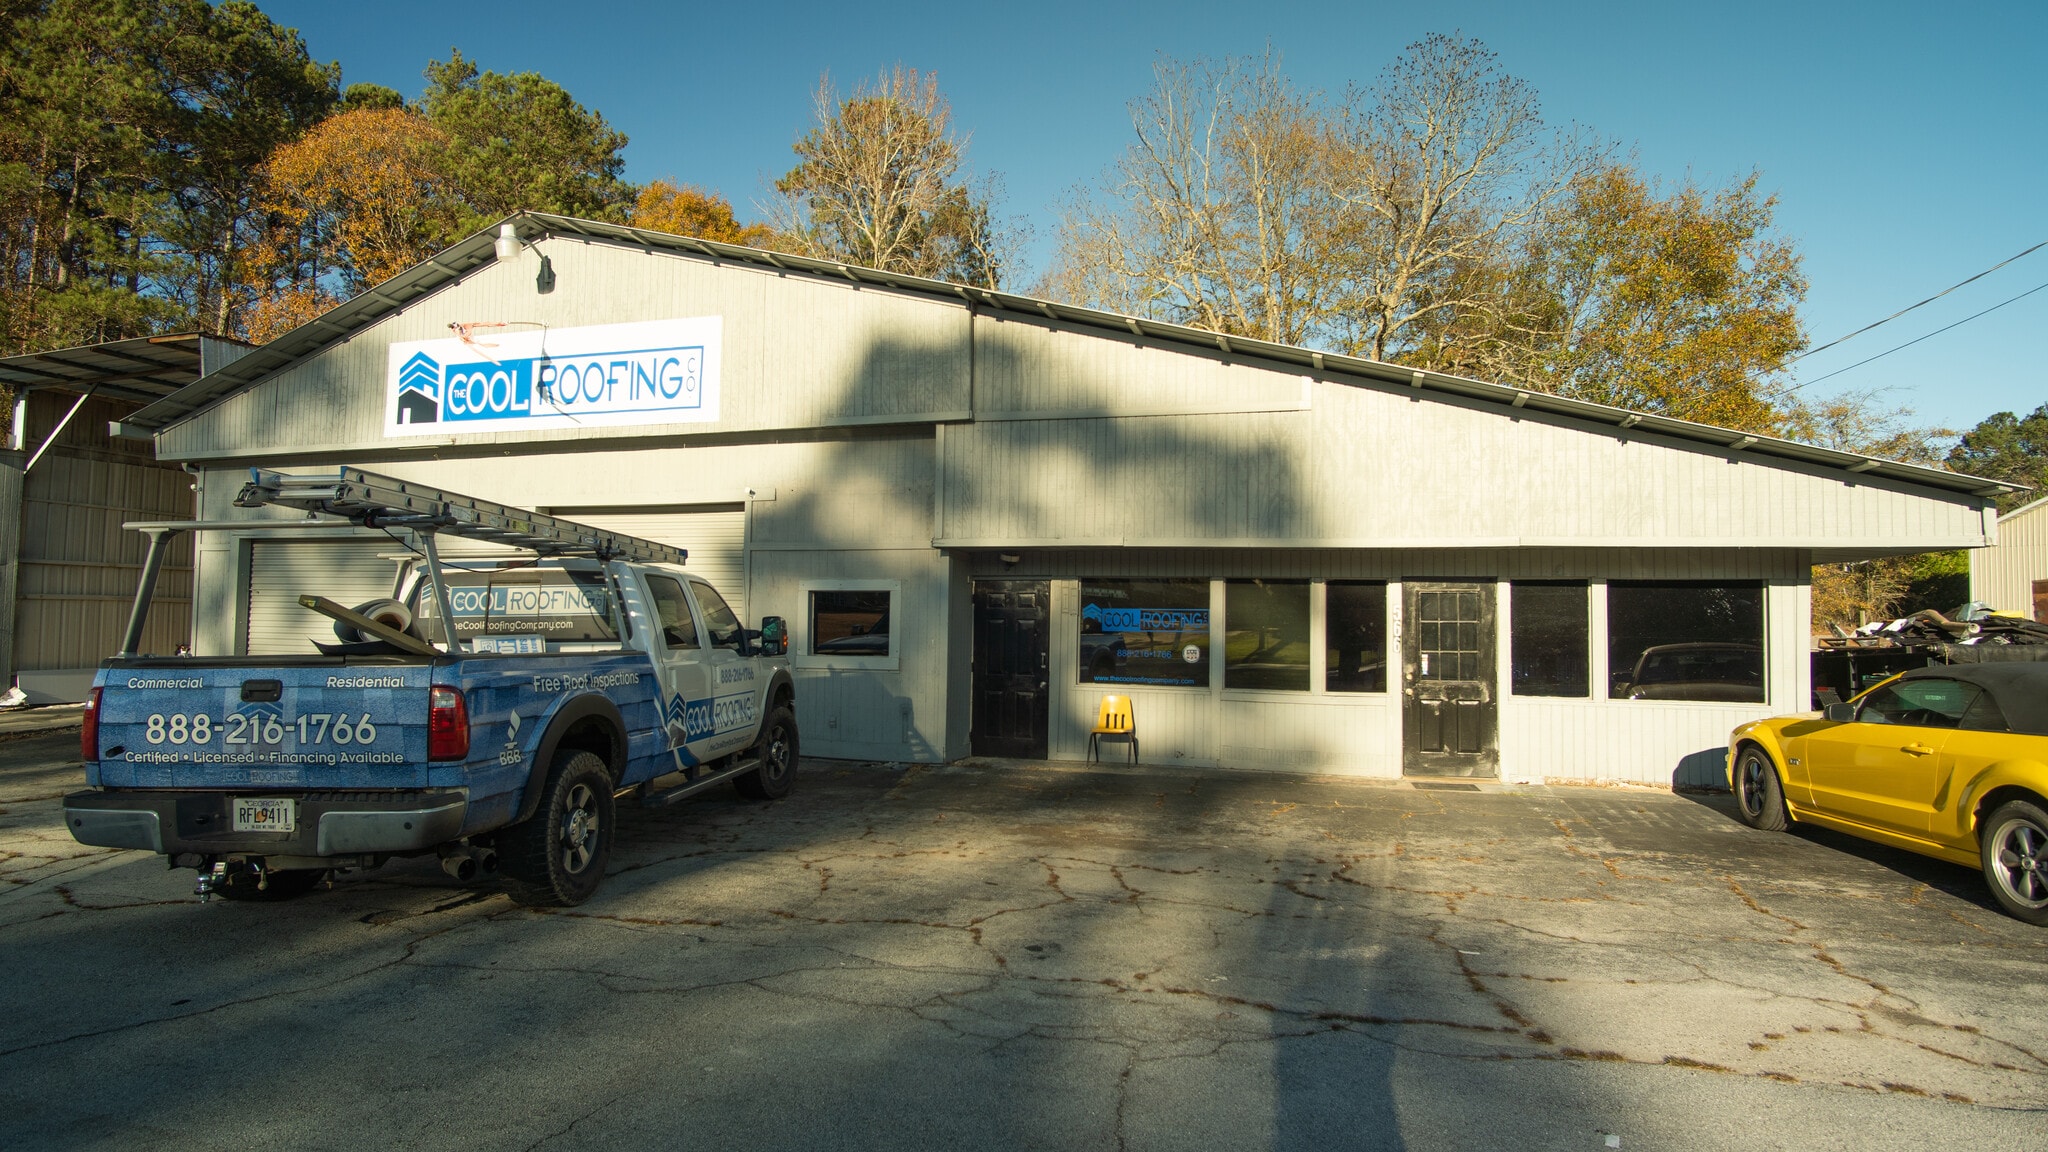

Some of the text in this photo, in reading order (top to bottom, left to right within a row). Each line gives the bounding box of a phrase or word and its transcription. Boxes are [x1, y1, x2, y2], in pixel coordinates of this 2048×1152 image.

[448, 370, 529, 415] COOL
[539, 357, 683, 405] ROOFING
[453, 389, 466, 399] THE
[453, 591, 505, 611] COOL
[510, 588, 595, 611] ROOFING
[453, 620, 573, 631] eCooloofingCompany.com
[1104, 611, 1139, 628] COOL
[1142, 611, 1203, 629] ROOFING
[127, 677, 203, 689] Commercial
[327, 676, 405, 688] Residential
[534, 671, 640, 692] Free Roof Inspections
[146, 713, 377, 744] 888-216-1766
[686, 704, 715, 736] COOL
[125, 751, 404, 766] Certified Licensed Financing Available
[500, 750, 522, 766] BBB
[239, 807, 288, 824] RFL9411
